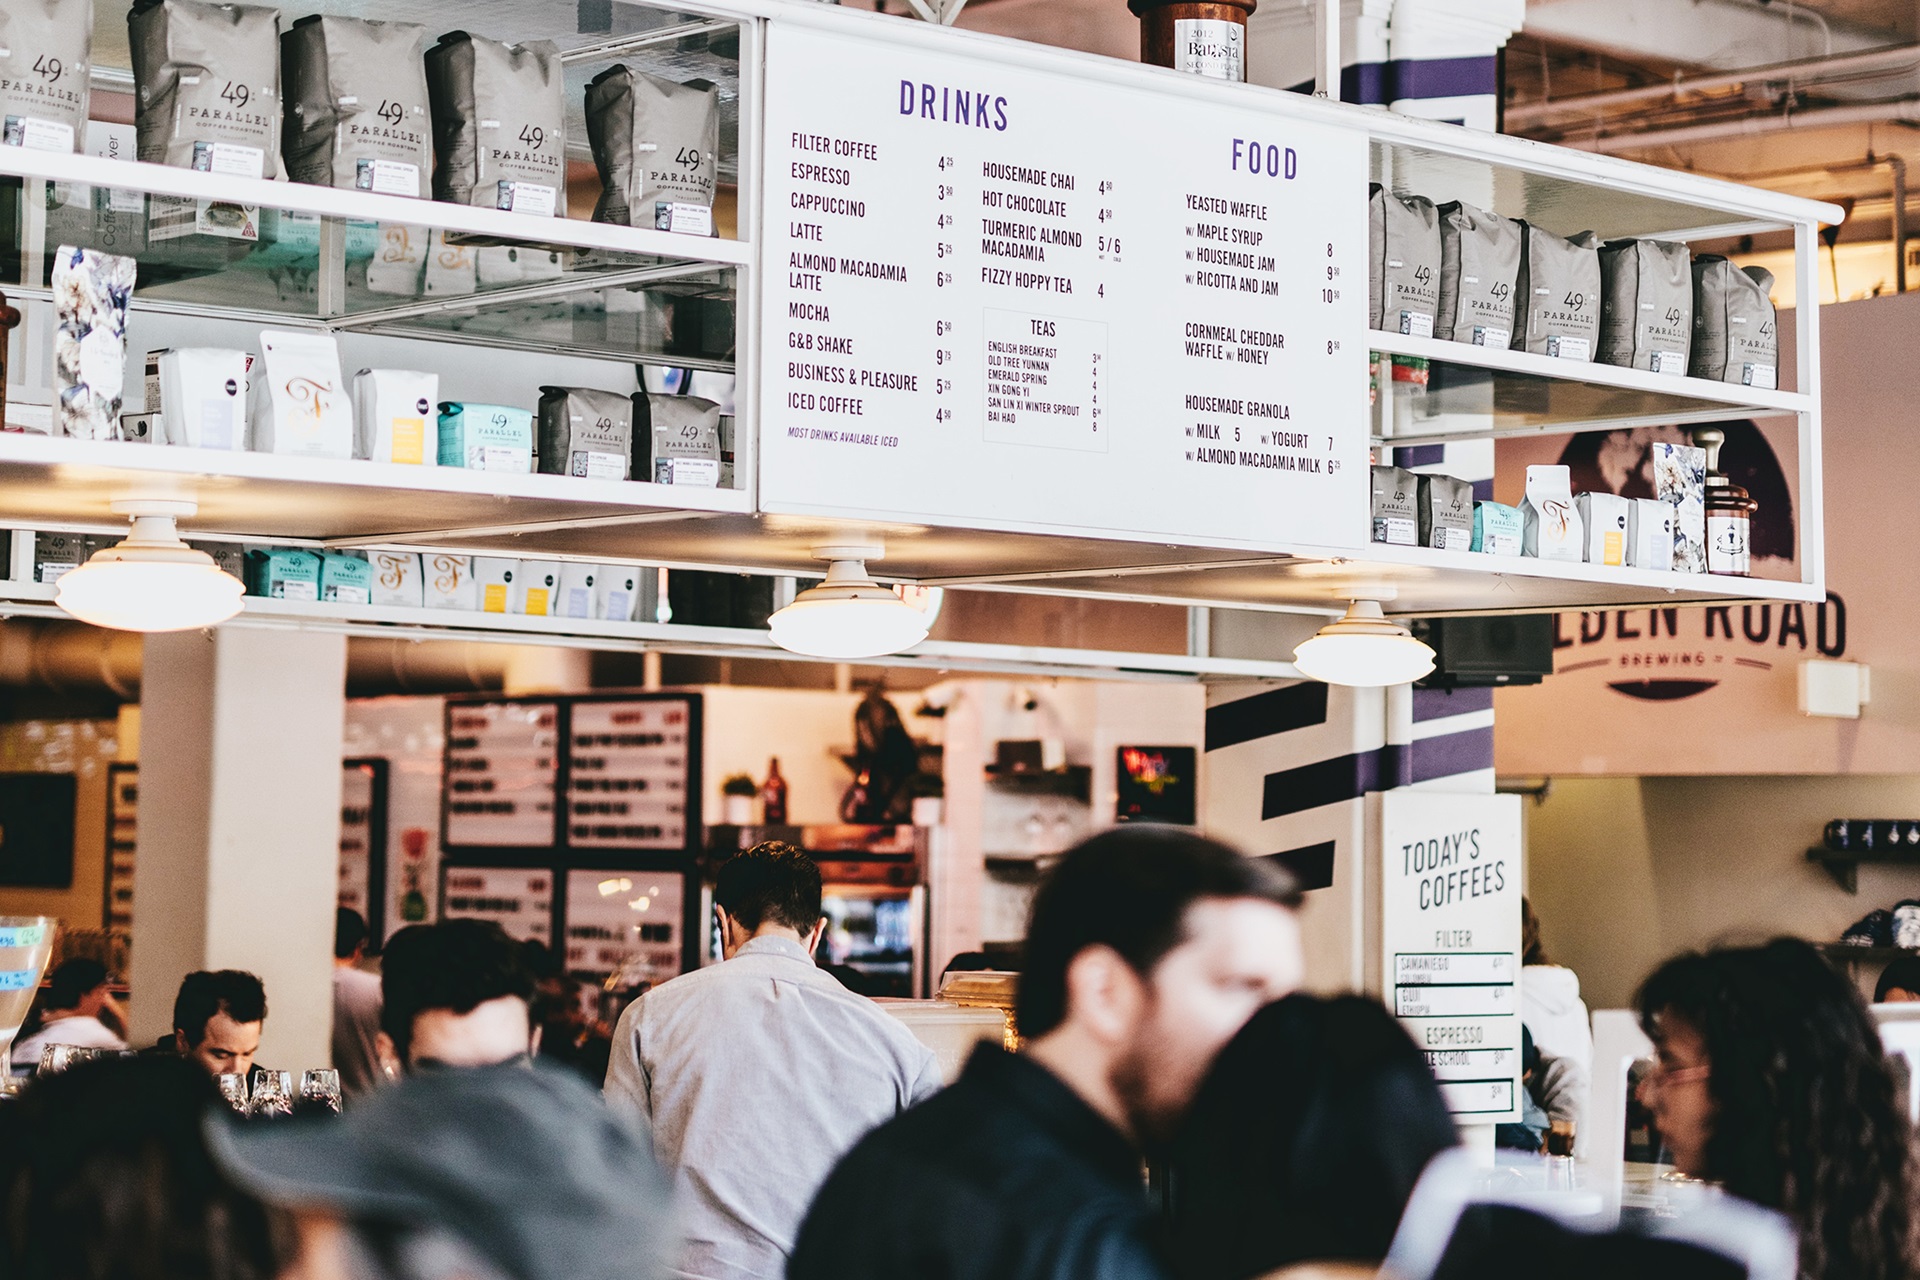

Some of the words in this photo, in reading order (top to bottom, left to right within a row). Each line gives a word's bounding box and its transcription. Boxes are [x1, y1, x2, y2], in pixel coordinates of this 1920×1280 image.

[1, 80, 80, 104] PARALLEL
[190, 107, 268, 127] PARALLEL
[900, 80, 1008, 132] DRINKS
[196, 122, 227, 130] COFFEE
[230, 126, 264, 135] ROASTERS
[350, 124, 421, 144] PARALLEL
[388, 142, 418, 152] ROASTERS
[493, 150, 559, 167] PARALLEL
[792, 132, 830, 154] FILTER
[834, 139, 878, 161] COFFEE
[528, 166, 556, 174] ROASTERS
[1232, 138, 1297, 180] FOOD
[792, 162, 850, 186] ESPRESSO
[983, 162, 1046, 186] HOUSEMADE
[1050, 172, 1074, 191] CHAI
[791, 192, 866, 218] CAPPUCCINO
[982, 190, 1002, 208] HOT
[1006, 194, 1066, 218] CHOCOLATE
[1186, 194, 1228, 214] YEASTED
[1230, 201, 1268, 220] WAFFLE
[790, 222, 823, 242] LATTE
[982, 218, 1036, 242] TURMERIC
[1040, 228, 1082, 248] ALMOND
[1197, 223, 1228, 242] MAPLE
[1232, 228, 1263, 246] SYRUP
[1327, 243, 1333, 258] 8
[982, 238, 1045, 262] MACADAMIA
[1197, 247, 1254, 270] HOUSEMADE
[1258, 258, 1276, 272] JAM
[790, 252, 836, 273] ALMOND
[840, 258, 908, 282] MACADAMIA
[790, 272, 822, 292] LATTE
[982, 267, 1012, 286] FIZZY
[1016, 272, 1050, 292] HOPPY
[1054, 277, 1073, 294] TEA
[1197, 271, 1237, 290] RICOTTA
[1240, 278, 1258, 294] AND
[1261, 282, 1279, 296] JAM
[789, 302, 830, 322] MOCHA
[1031, 319, 1056, 338] TEAS
[1186, 322, 1238, 343] CORNMEAL
[1240, 329, 1284, 349] CHEDDAR
[788, 332, 813, 350] G&B
[817, 335, 853, 355] SHAKE
[988, 340, 1018, 354] ENGLISH
[1020, 345, 1057, 358] BREAKFAST
[1185, 341, 1224, 360] WAFFLE
[1237, 348, 1269, 366] HONEY
[988, 355, 1001, 366] OLD
[1004, 356, 1020, 368] TREE
[1022, 359, 1050, 372] YUNNAN
[788, 362, 845, 384] BUSINESS
[849, 368, 857, 385] &
[861, 370, 918, 392] PLEASURE
[988, 368, 1020, 382] EMERALD
[1022, 373, 1048, 386] SPRING
[988, 383, 1000, 394] XIN
[1002, 385, 1020, 396] GONG
[1023, 386, 1030, 397] YI
[788, 392, 815, 410] ICED
[820, 396, 863, 416] COFFEE
[988, 397, 1001, 408] SAN
[1004, 398, 1014, 409] LIN
[1016, 400, 1024, 410] XI
[1026, 401, 1052, 414] WINTER
[1054, 404, 1080, 416] SPROUT
[1186, 394, 1244, 416] HOUSEMADE
[1247, 402, 1290, 420] GRANOLA
[988, 411, 1000, 422] BAI
[1002, 413, 1016, 424] HAO
[580, 432, 622, 442] PARALLEL
[787, 426, 808, 439] MOST
[810, 429, 838, 442] DRINKS
[840, 432, 878, 446] AVAILABLE
[880, 436, 898, 448] ICED
[1196, 423, 1220, 440] MILK
[1272, 430, 1308, 449] YOGURT
[1197, 448, 1236, 466] ALMOND
[1240, 451, 1296, 472] MACADAMIA
[1298, 457, 1320, 474] MILK
[1705, 591, 1846, 658] ROAD
[1621, 653, 1705, 668] BREWING
[1402, 828, 1480, 876] TODAY'S
[1420, 860, 1504, 910] COFFEES
[1436, 930, 1472, 948] FILTER
[1401, 957, 1449, 970] SAMANIEGO
[1426, 1026, 1483, 1044] ESPRESSO
[1438, 1052, 1470, 1066] SCHOOL
